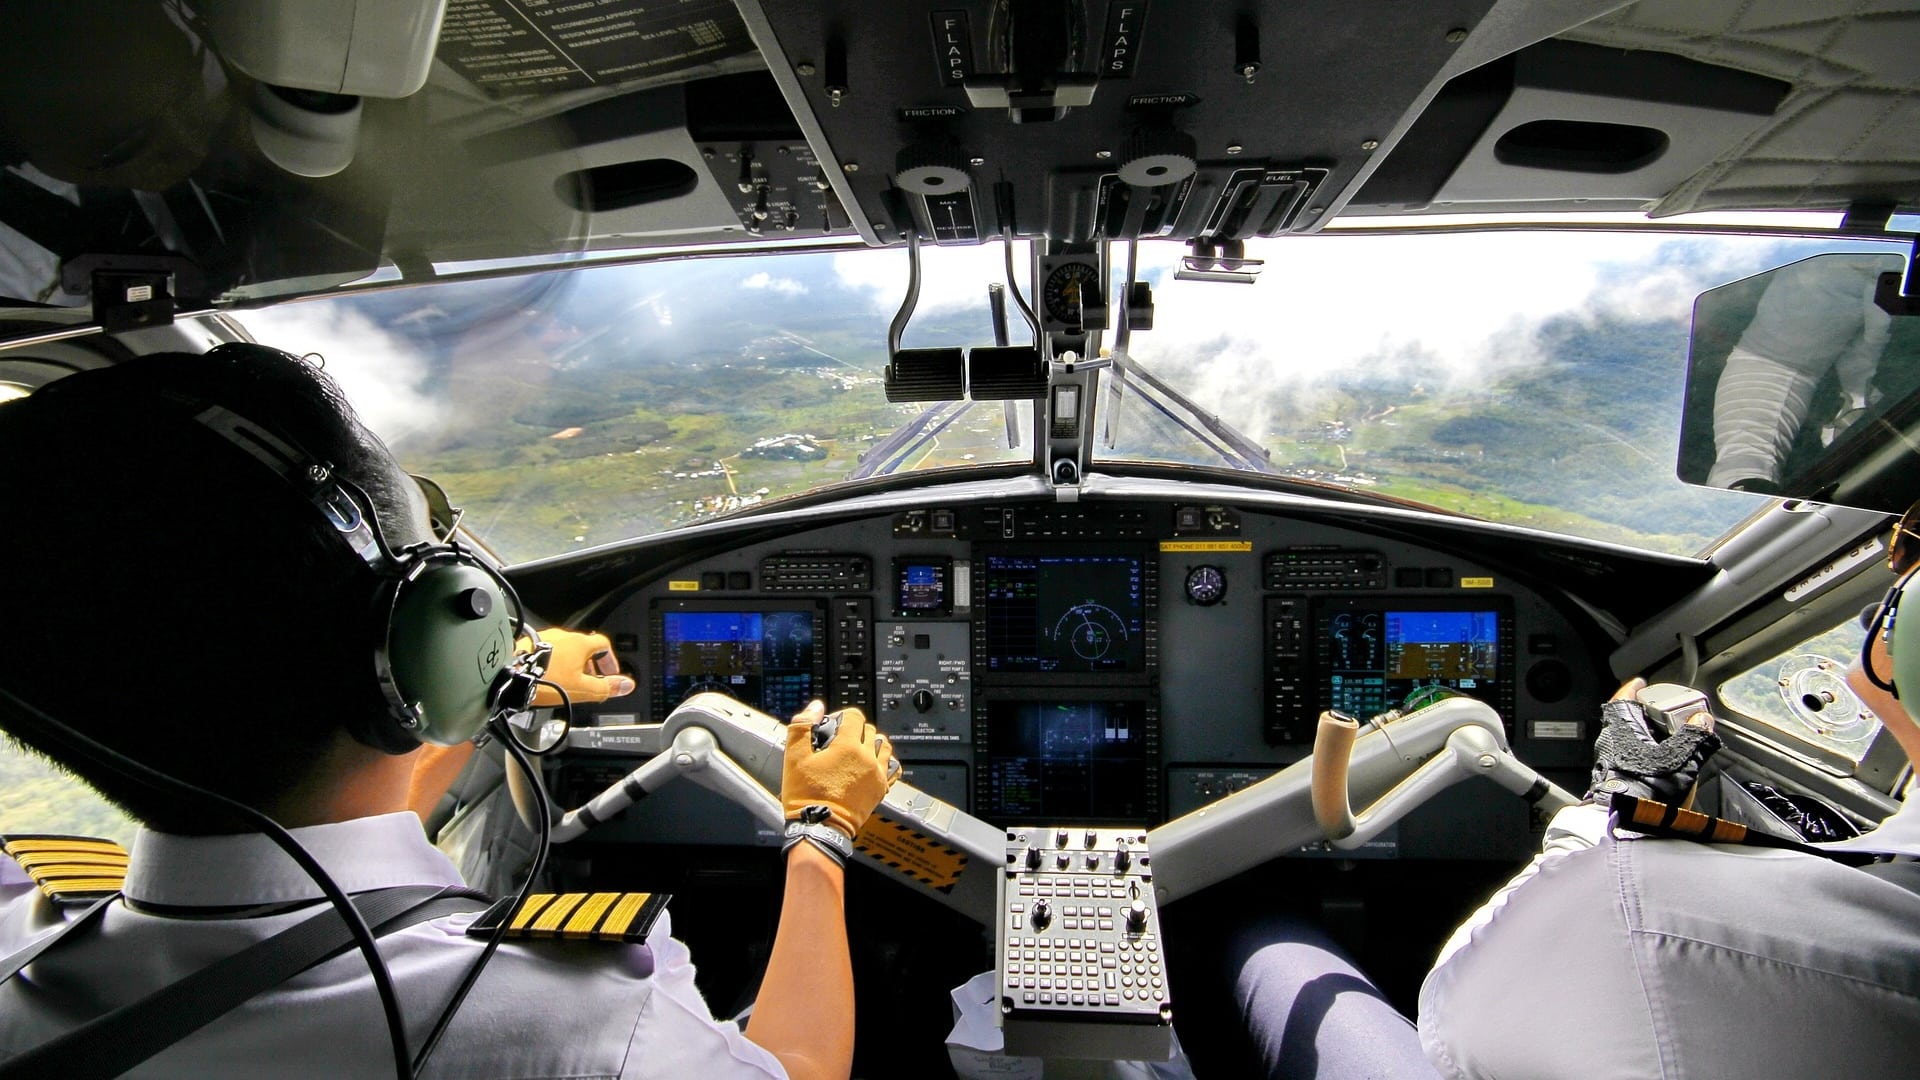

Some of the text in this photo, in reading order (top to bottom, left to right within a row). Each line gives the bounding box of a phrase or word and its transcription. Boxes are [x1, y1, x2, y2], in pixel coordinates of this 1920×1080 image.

[944, 19, 964, 79] FLAPS
[1111, 8, 1134, 70] FLAPS
[904, 108, 956, 117] FRICTION
[1132, 95, 1186, 104] FRICTION
[1791, 564, 1834, 593] STEP
